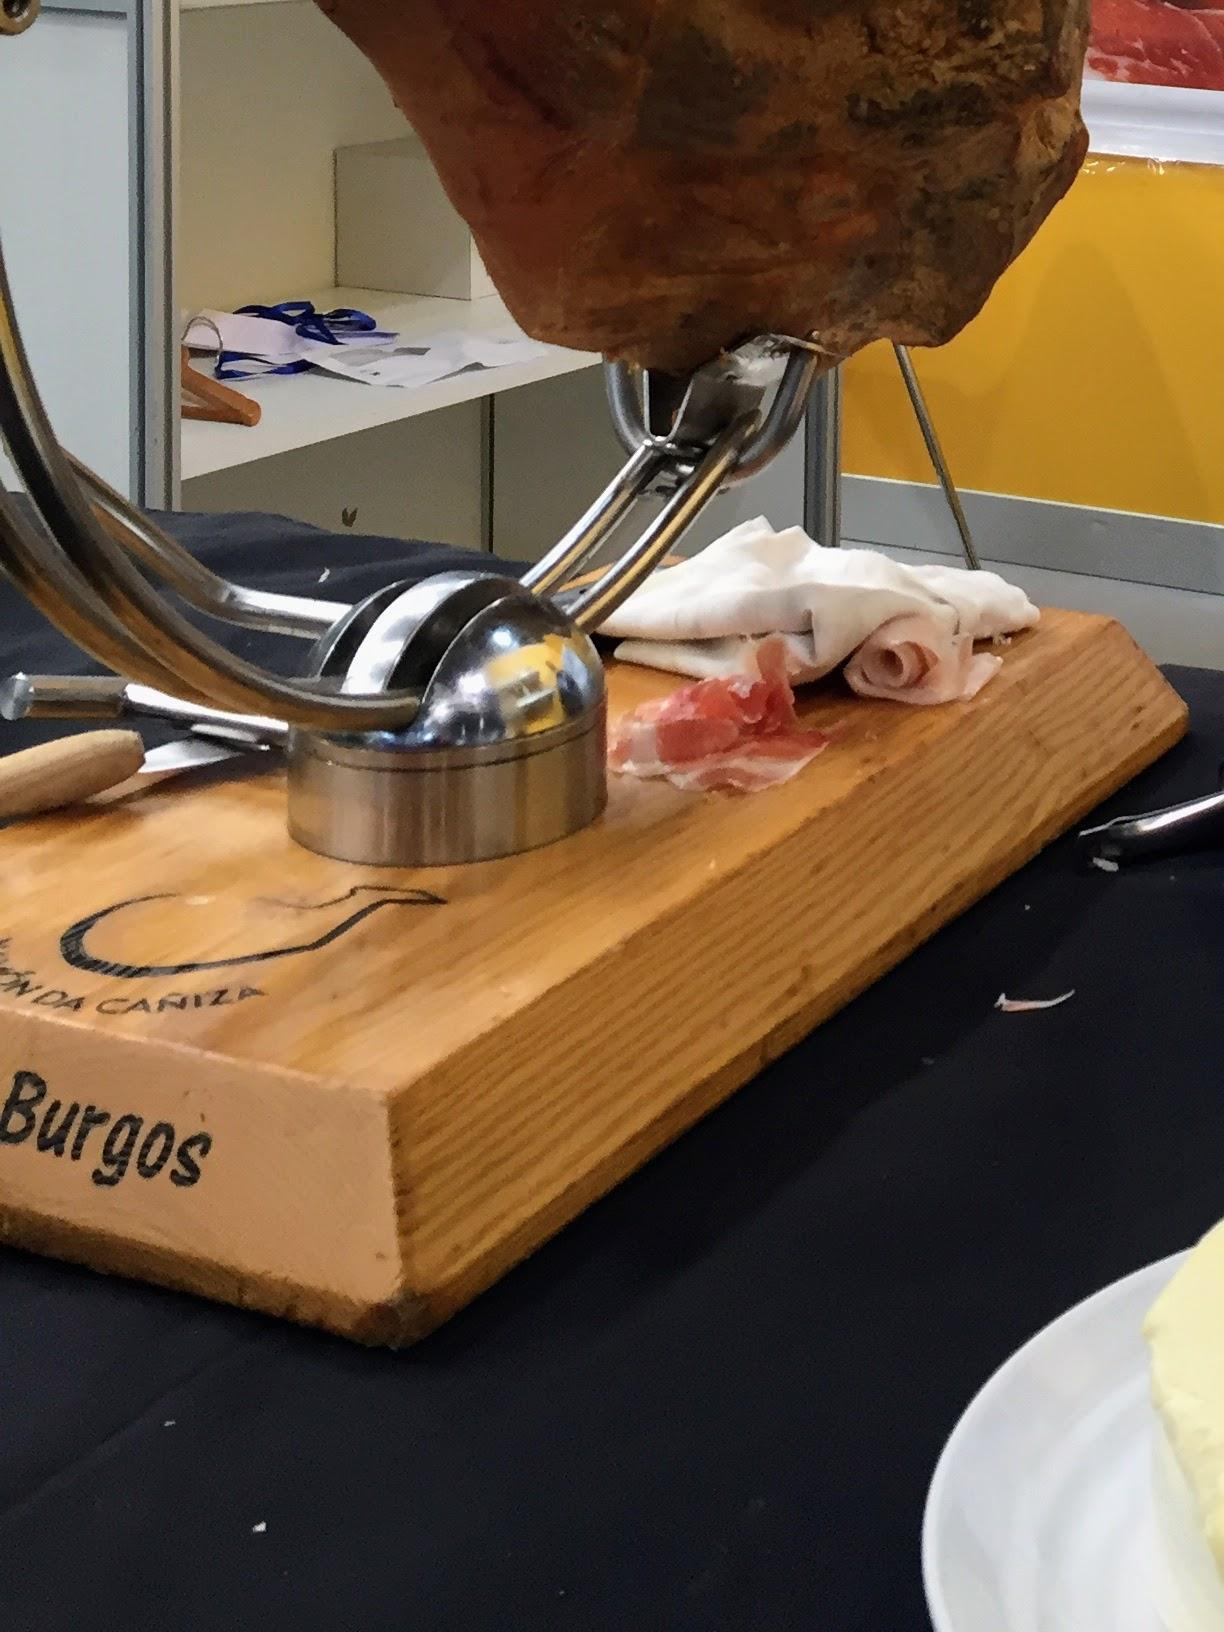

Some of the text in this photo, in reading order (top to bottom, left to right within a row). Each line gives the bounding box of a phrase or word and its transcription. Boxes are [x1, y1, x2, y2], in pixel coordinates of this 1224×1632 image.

[31, 989, 86, 1012] DA
[96, 987, 268, 1015] CAÑIZA
[0, 1070, 213, 1186] Burgos
